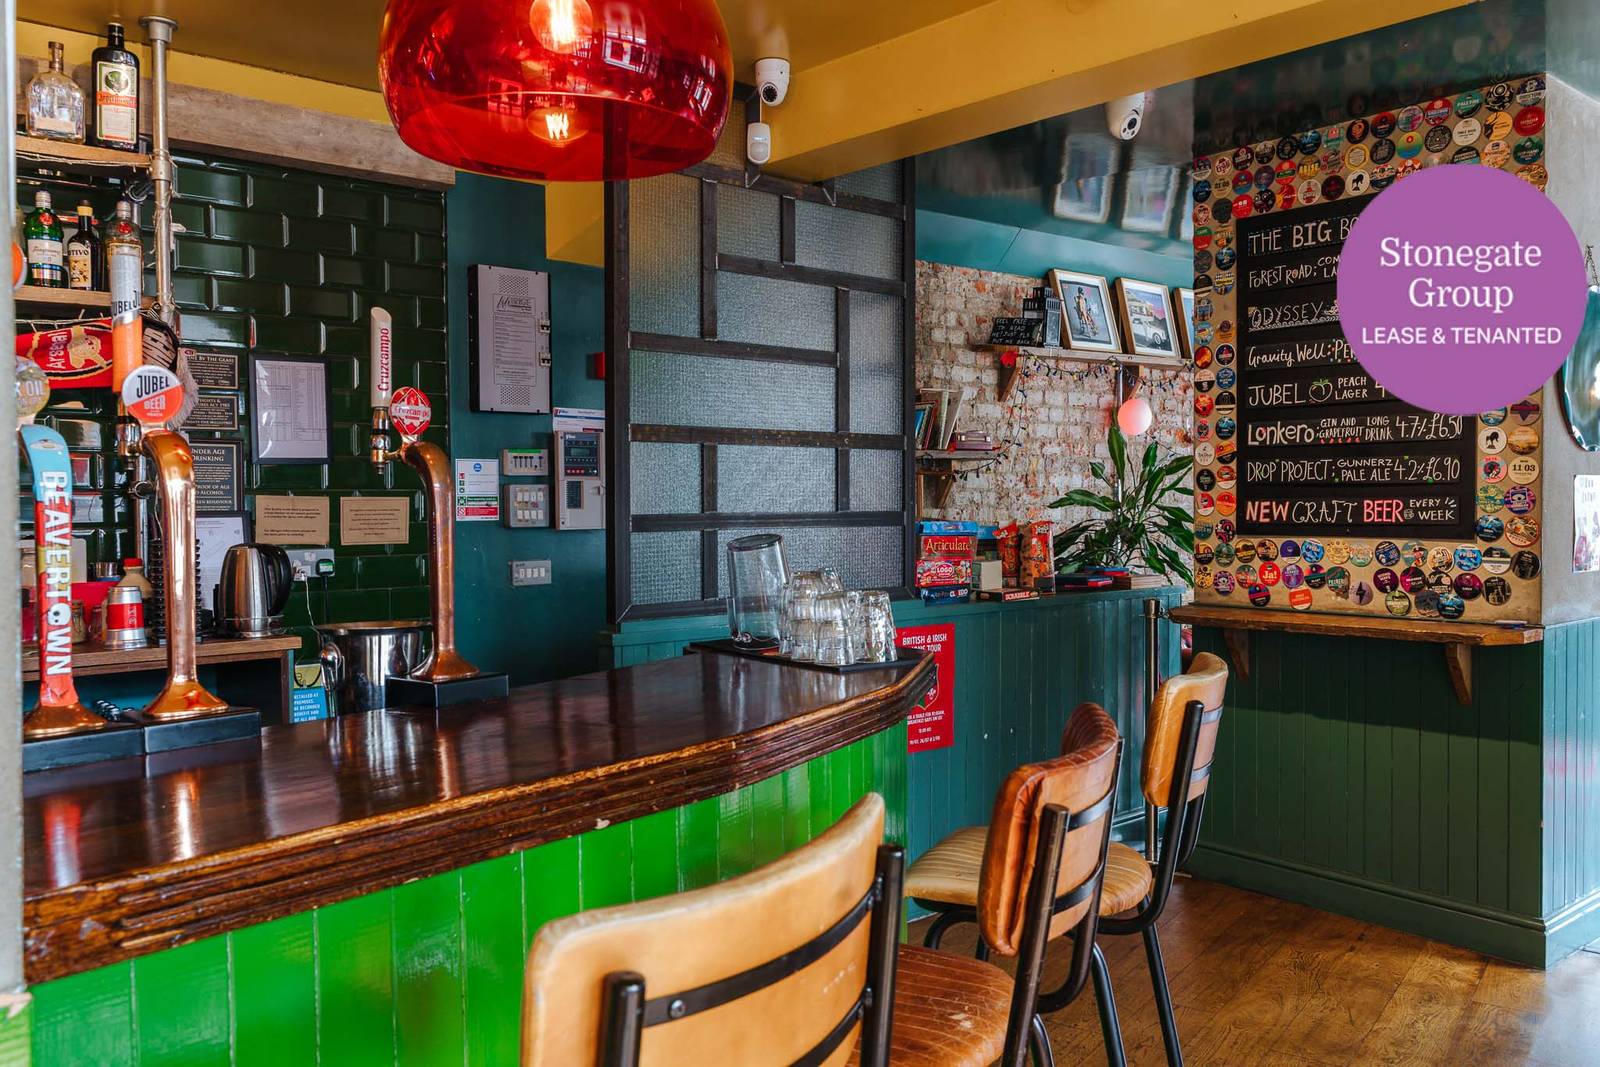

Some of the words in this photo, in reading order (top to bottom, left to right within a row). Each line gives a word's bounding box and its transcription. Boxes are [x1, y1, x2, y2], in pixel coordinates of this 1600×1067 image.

[1248, 229, 1282, 254] THE
[1292, 220, 1332, 248] BIG
[1249, 264, 1286, 288] FOREST
[1252, 301, 1324, 328] ODYSSEY
[378, 328, 390, 392] Cruzcampo
[1248, 346, 1295, 368] Gravity
[136, 375, 170, 398] JUBEL
[1338, 376, 1368, 388] PEACH
[144, 394, 166, 410] BEER
[1248, 382, 1306, 407] JUBEL
[1334, 392, 1368, 400] LAGER
[1320, 418, 1338, 428] GIN
[1340, 417, 1356, 426] AND
[1367, 416, 1390, 426] LONG
[1319, 426, 1364, 439] GRAPEFRUIT
[1364, 426, 1394, 442] DRINK
[1248, 461, 1277, 482] DROP
[1337, 458, 1394, 468] GUNNERZ
[1342, 469, 1366, 482] PALE
[1370, 468, 1390, 481] ALE
[1422, 456, 1460, 481] £6.90
[1246, 501, 1290, 522] NEW
[1292, 500, 1358, 524] CRAFT
[1363, 500, 1404, 523] BEER
[1410, 498, 1441, 508] EVERY
[1418, 510, 1455, 520] WEEK
[1262, 571, 1278, 579] Ja!
[902, 635, 926, 646] BRITISH
[926, 634, 932, 644] &
[932, 633, 948, 643] IRISH
[927, 643, 942, 652] TOUR
